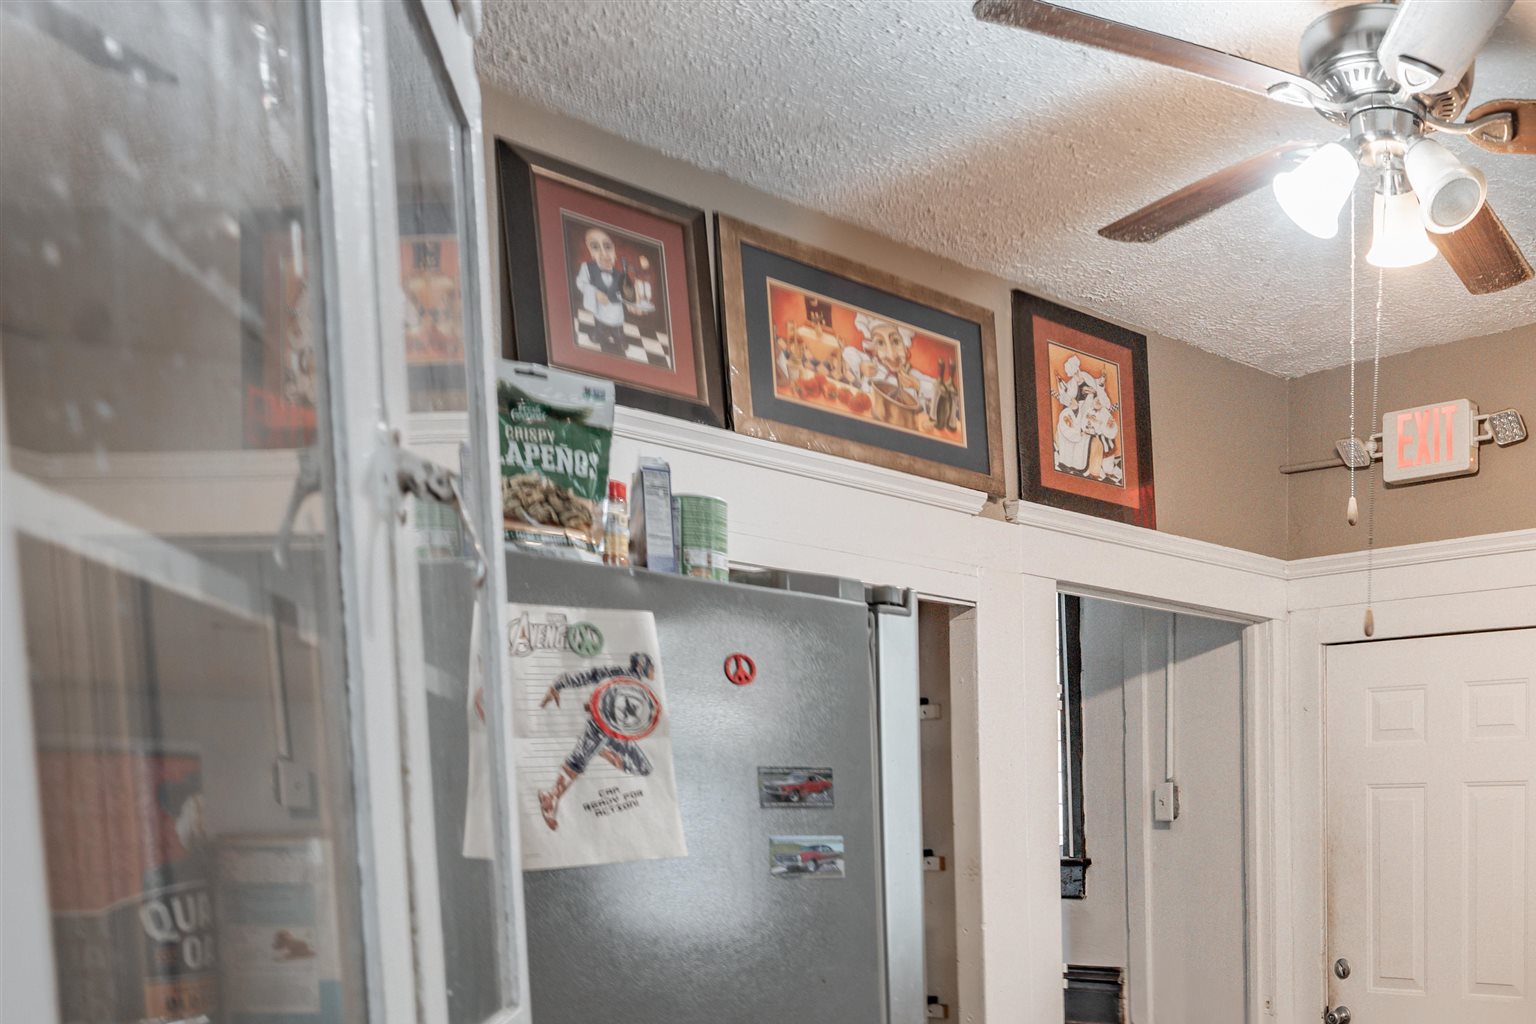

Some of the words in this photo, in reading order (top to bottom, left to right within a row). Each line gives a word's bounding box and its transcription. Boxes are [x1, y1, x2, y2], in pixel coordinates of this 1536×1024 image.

[505, 424, 555, 445] CRISPY
[1397, 406, 1457, 468] EXIT
[501, 440, 600, 480] APEÑOS
